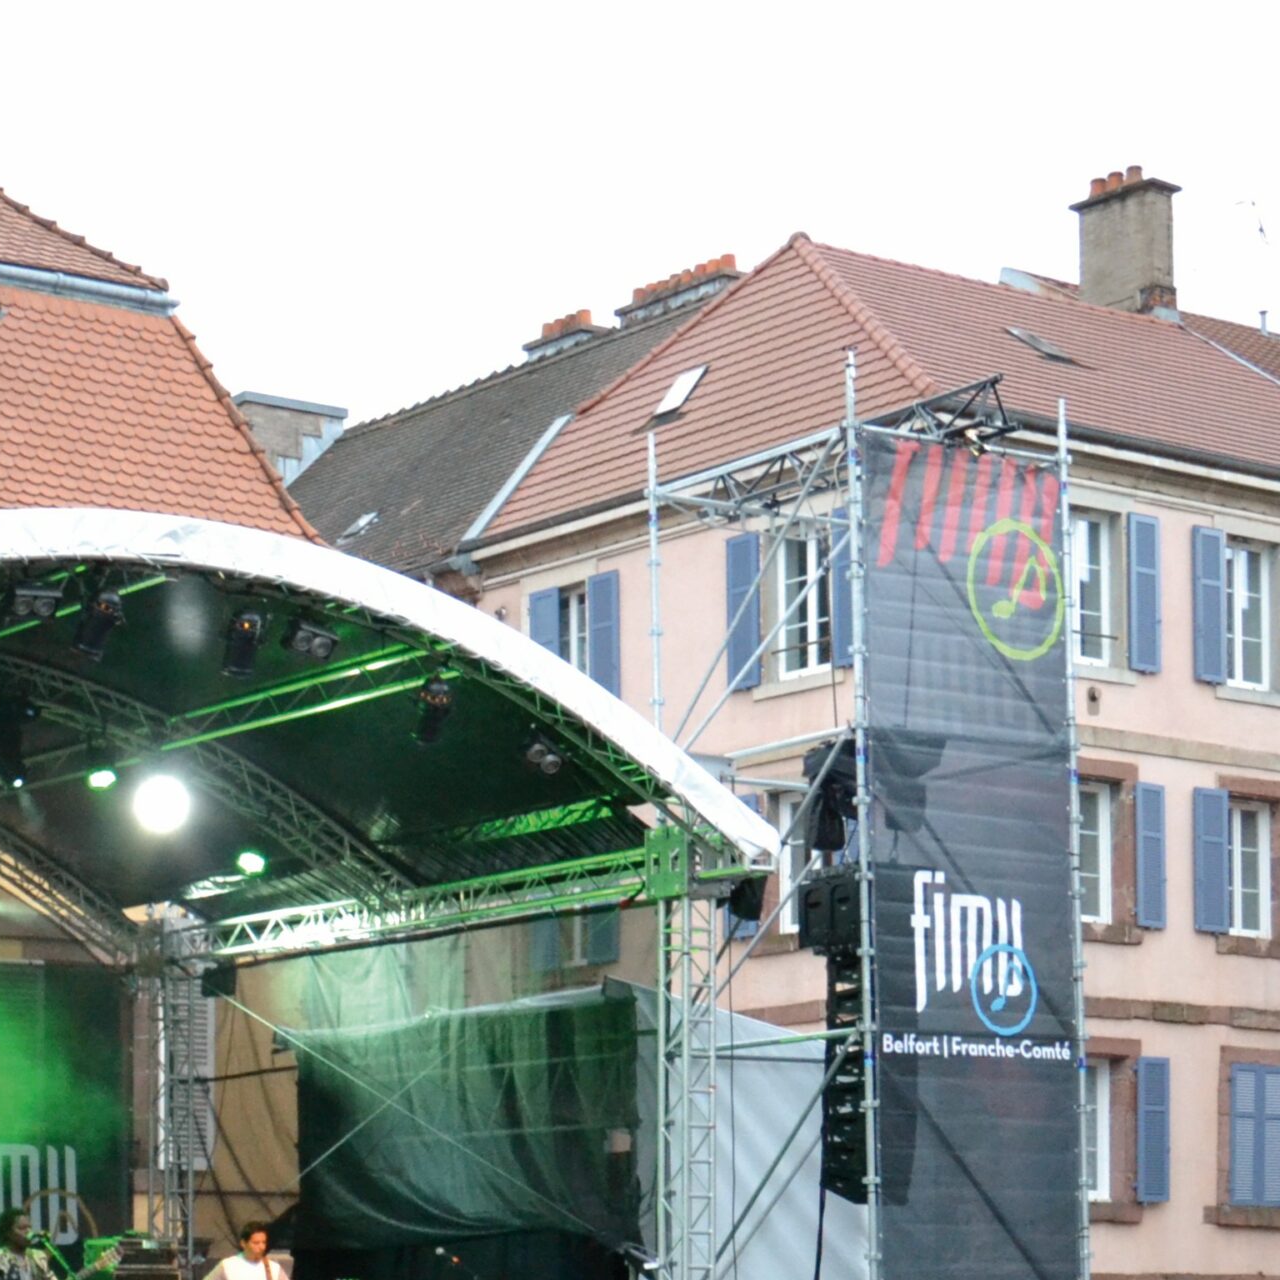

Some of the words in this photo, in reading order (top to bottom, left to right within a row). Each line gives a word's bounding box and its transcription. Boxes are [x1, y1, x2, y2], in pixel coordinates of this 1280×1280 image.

[910, 869, 1024, 1014] fimu
[882, 1033, 939, 1056] Belfort
[951, 1036, 1071, 1060] Franche-Comté
